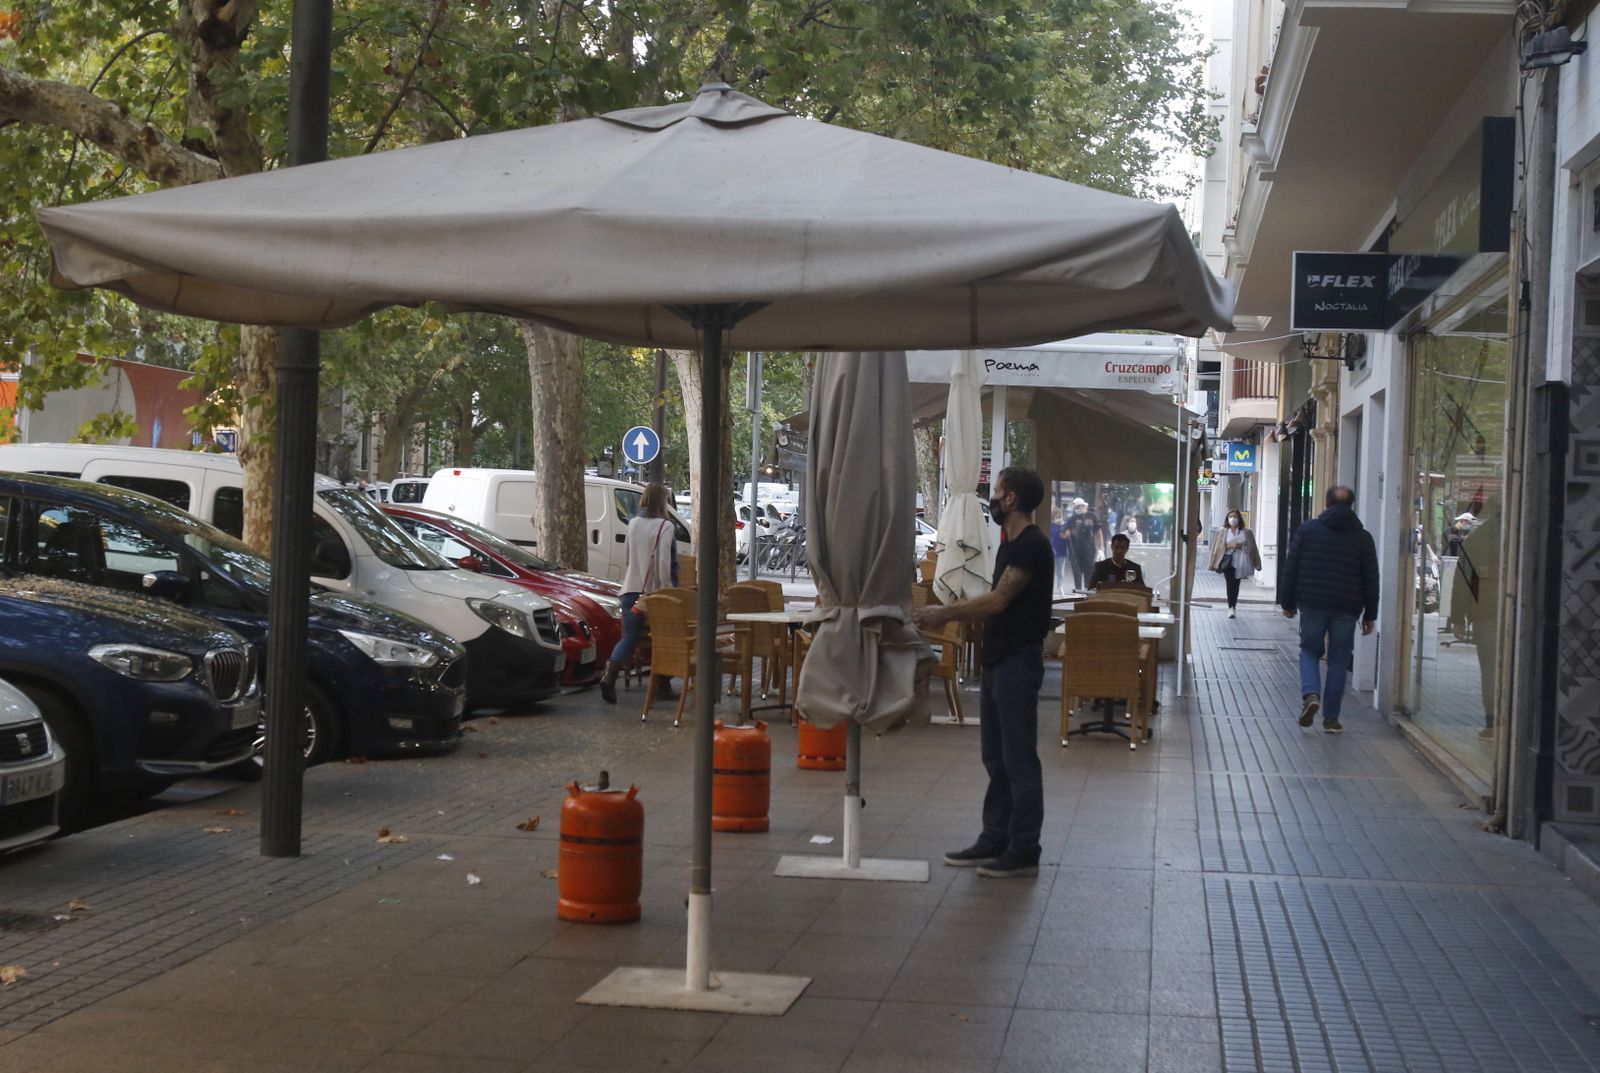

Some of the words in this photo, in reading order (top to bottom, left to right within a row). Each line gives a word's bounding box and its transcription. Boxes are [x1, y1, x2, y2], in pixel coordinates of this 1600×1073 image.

[1320, 274, 1377, 288] FLEX
[1314, 300, 1369, 312] NOCTALIA
[984, 358, 1040, 373] Poema
[1104, 361, 1171, 376] Cruzcampo
[1118, 375, 1157, 384] ESPECIAL
